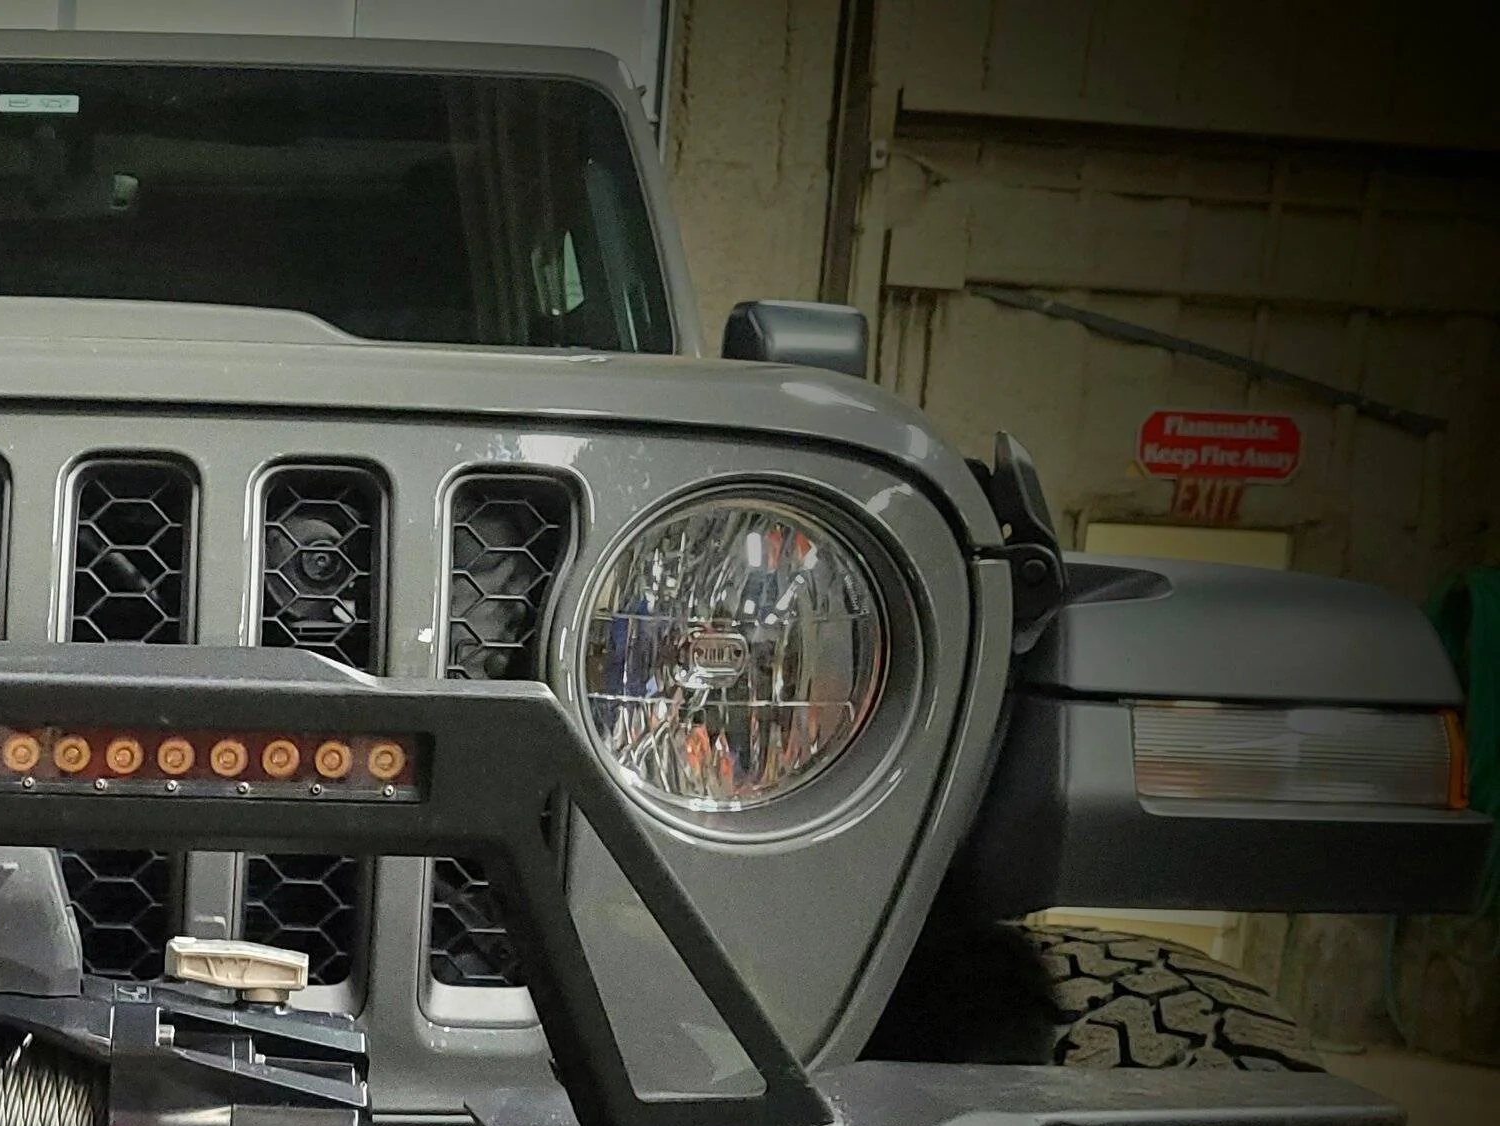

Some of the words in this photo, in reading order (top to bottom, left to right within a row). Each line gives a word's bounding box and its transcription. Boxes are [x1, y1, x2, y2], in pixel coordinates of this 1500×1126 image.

[1163, 415, 1279, 440] Flammable
[1143, 443, 1198, 469] Keep
[1200, 444, 1241, 466] Fire
[1242, 447, 1295, 473] Away
[1175, 477, 1245, 522] EXIT
